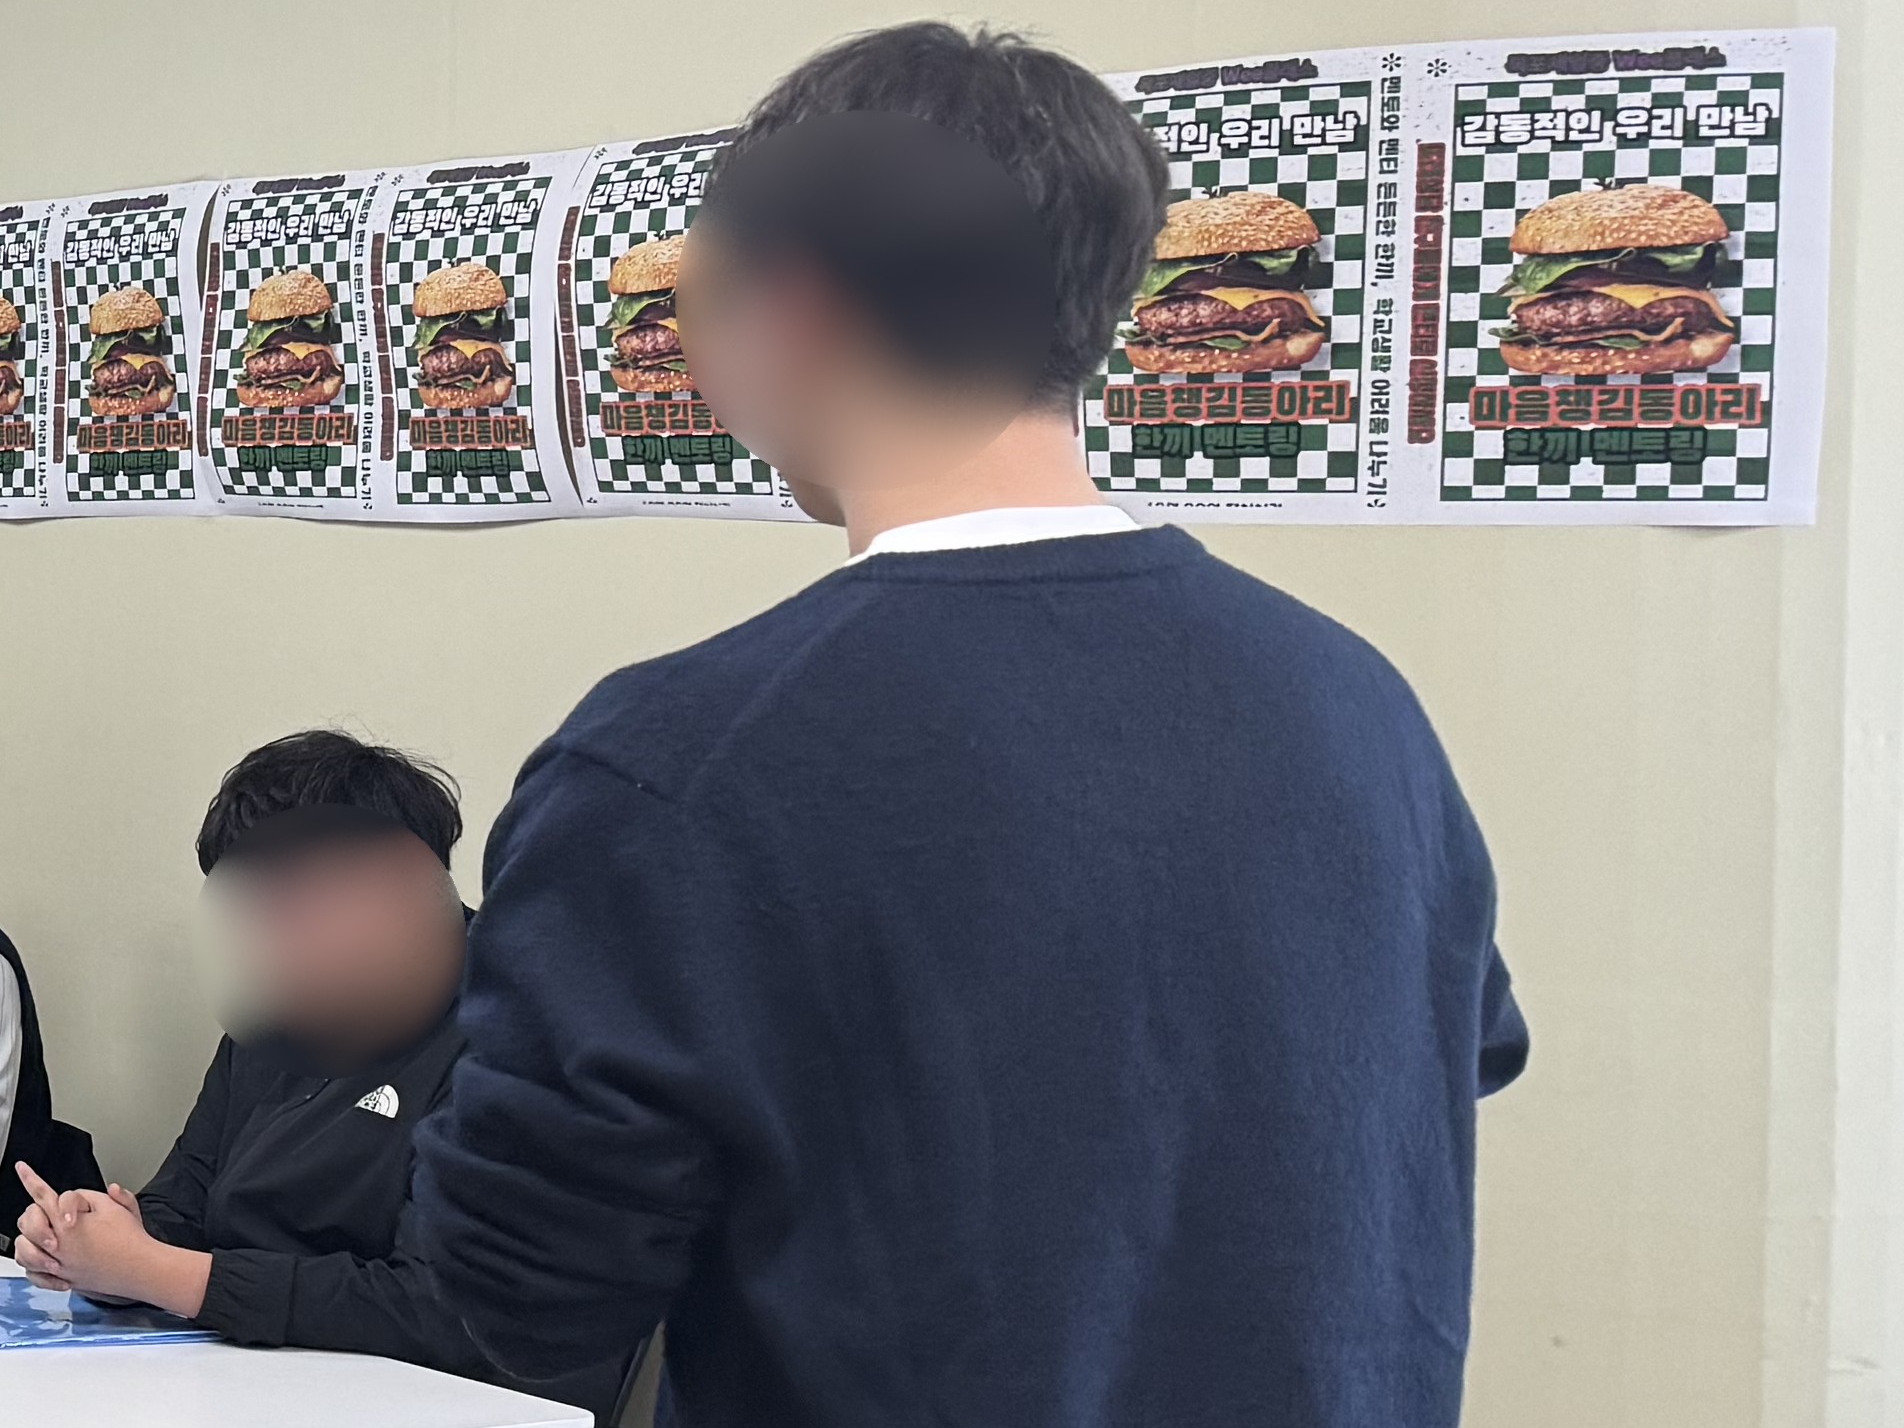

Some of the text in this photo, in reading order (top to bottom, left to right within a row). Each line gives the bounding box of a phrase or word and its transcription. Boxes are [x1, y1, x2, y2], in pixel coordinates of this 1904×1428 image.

[1381, 76, 1401, 130] 멘토와
[1154, 110, 1359, 154] 적인 우리 만남
[1462, 103, 1771, 147] 감동적인 우리 만남
[1379, 139, 1399, 174] 멘티
[590, 172, 709, 207] 감동적인 우리
[227, 209, 352, 245] 감동적인 우리 만남
[393, 198, 540, 236] 감동적인 우리 만남
[1376, 182, 1397, 237] 든든한
[65, 226, 177, 263] 감동적인 우리 만남
[1371, 243, 1395, 287] 한끼,
[600, 401, 729, 436] 마음챙김동
[1104, 380, 1351, 422] 마음챙김동아리
[1369, 379, 1390, 435] 어려움
[1469, 383, 1762, 427] 마음챙김동아리
[222, 413, 354, 447] 마음챙김동아리
[409, 415, 534, 449] 마음챙김동아리
[1131, 421, 1302, 459] 한끼 멘토링
[1503, 427, 1708, 465] 한끼 멘토링
[1367, 440, 1389, 496] 나누기
